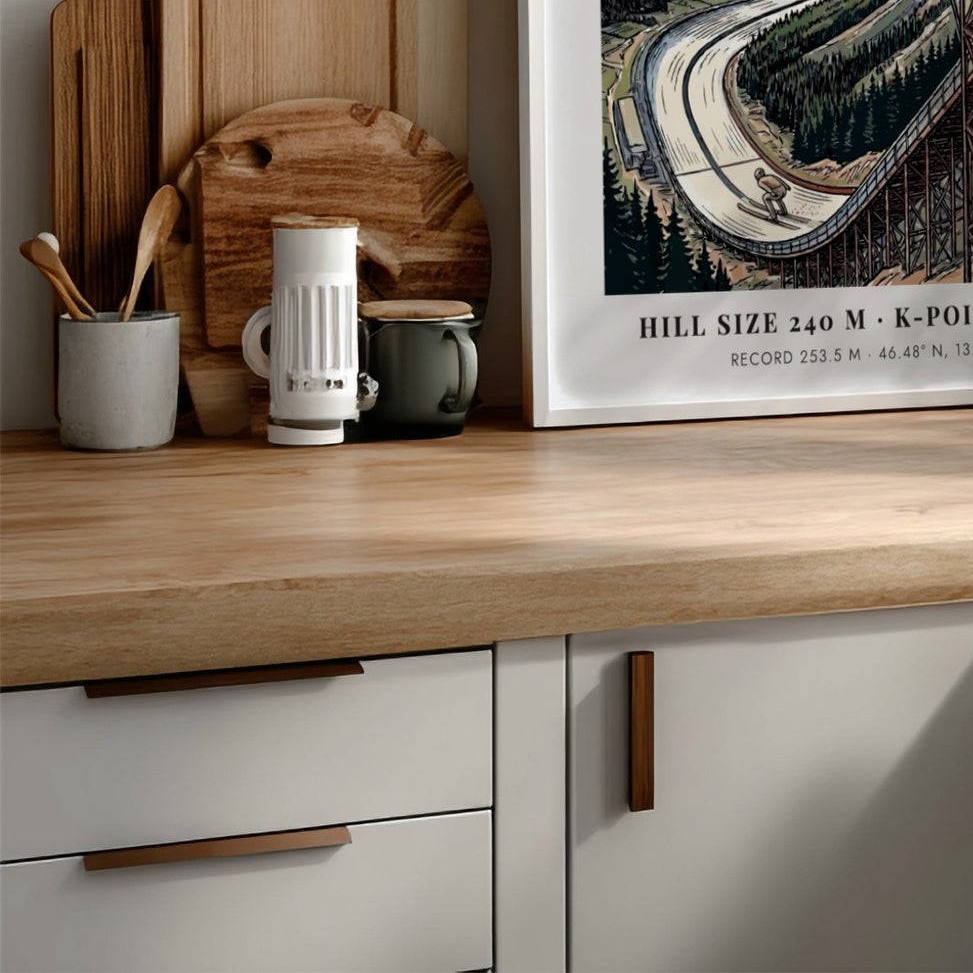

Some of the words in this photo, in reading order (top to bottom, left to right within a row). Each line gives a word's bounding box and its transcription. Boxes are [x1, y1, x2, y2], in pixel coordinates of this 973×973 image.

[638, 314, 706, 340] HILL
[717, 311, 778, 337] SIZE
[789, 314, 834, 336] 240
[845, 308, 867, 331] M
[730, 350, 794, 367] RECORD
[799, 347, 842, 364] 253.5
[848, 347, 862, 362] M
[878, 343, 927, 361] 46.48°
[931, 343, 949, 360] N,
